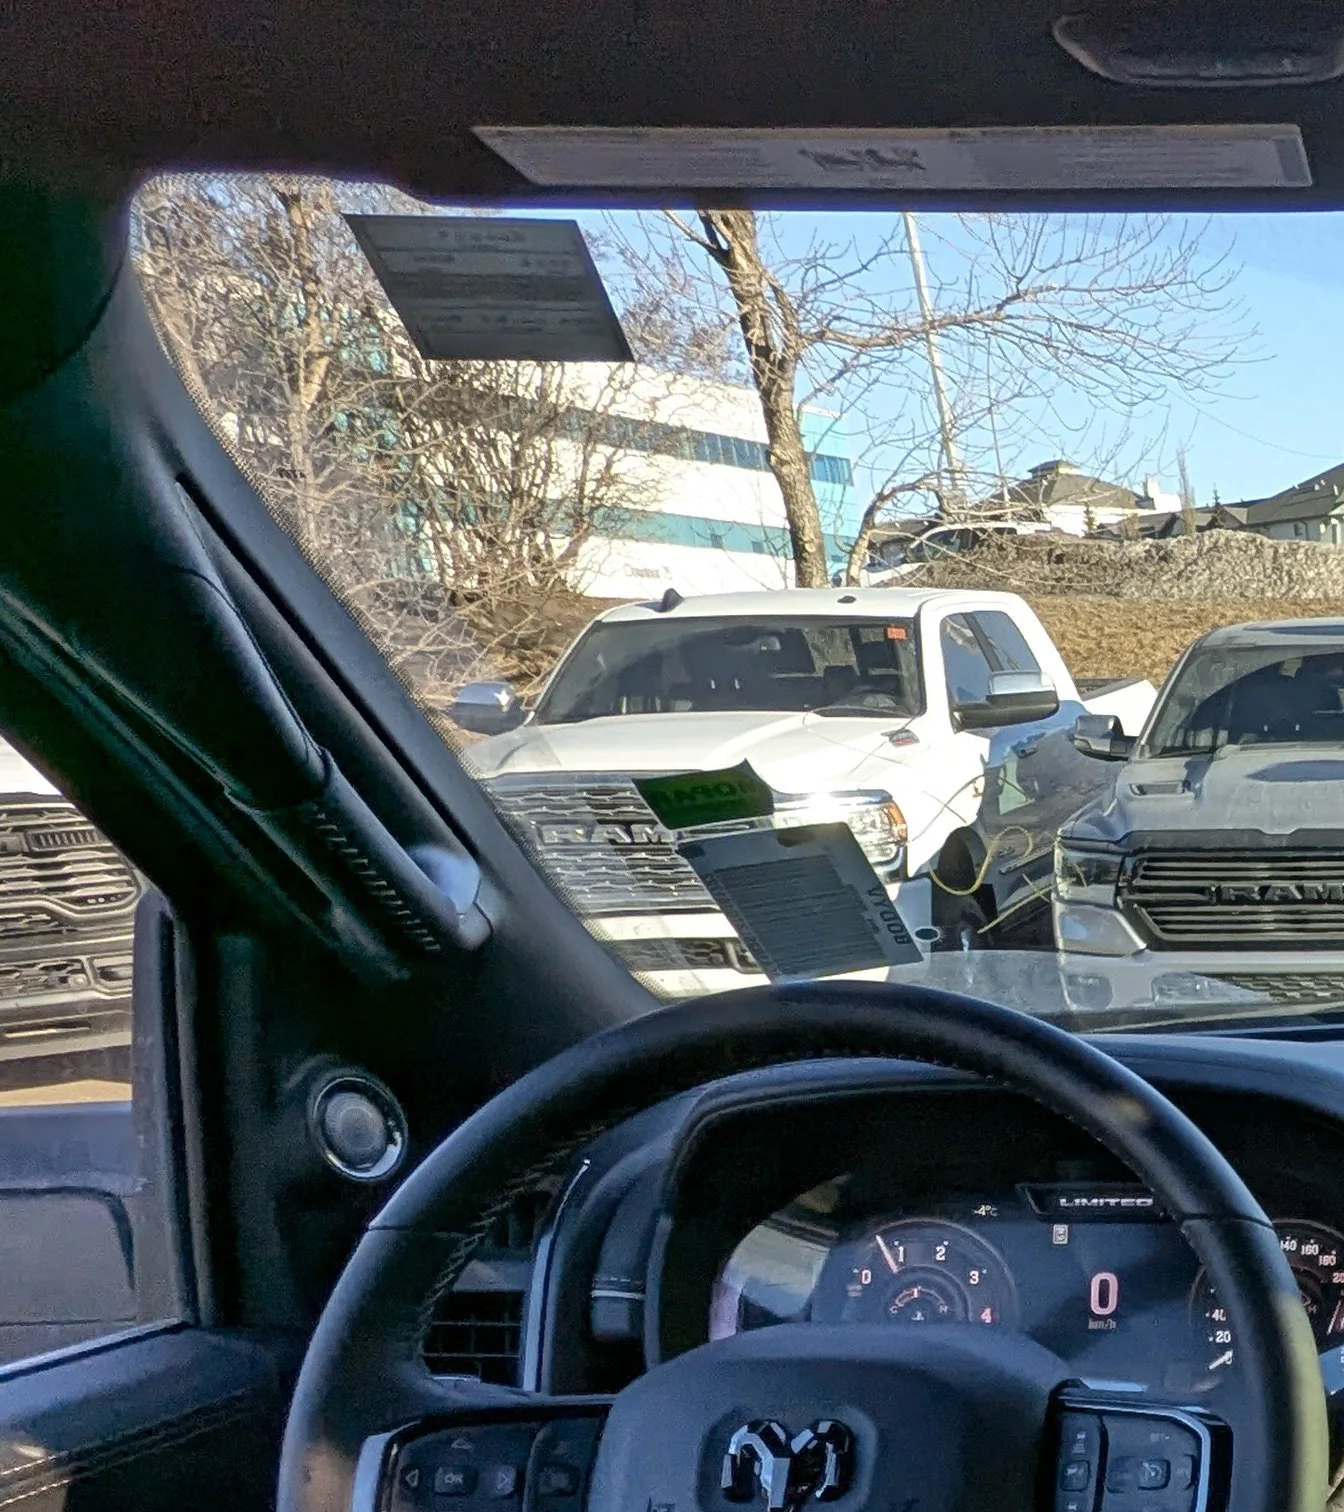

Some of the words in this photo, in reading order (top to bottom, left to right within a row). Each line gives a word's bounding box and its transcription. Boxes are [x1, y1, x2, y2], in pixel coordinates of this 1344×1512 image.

[542, 821, 673, 844] RAM
[1059, 1197, 1154, 1207] LIMITED
[897, 1246, 905, 1262] 1
[935, 1245, 946, 1261] 2
[1301, 1243, 1320, 1256] 160
[861, 1269, 872, 1285] 0
[969, 1270, 979, 1285] 3
[1089, 1271, 1120, 1316] 0
[980, 1307, 992, 1323] 4
[1215, 1335, 1232, 1344] 20
